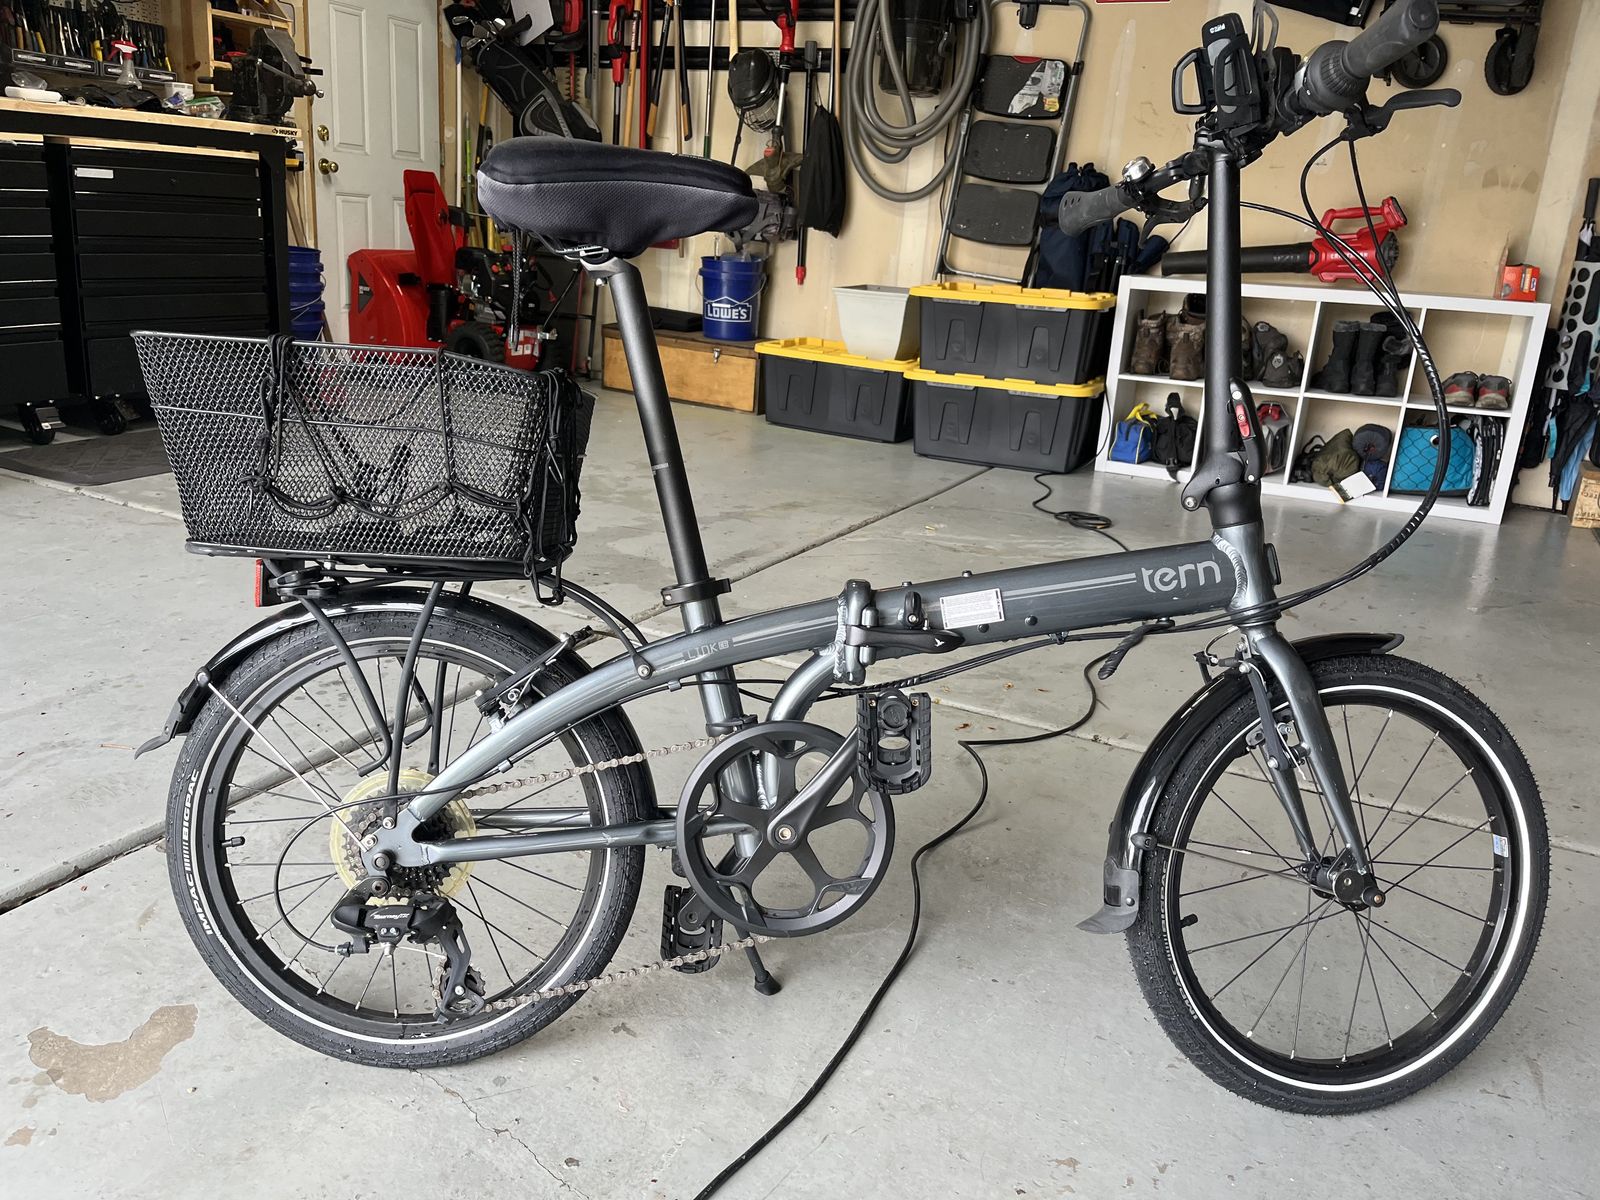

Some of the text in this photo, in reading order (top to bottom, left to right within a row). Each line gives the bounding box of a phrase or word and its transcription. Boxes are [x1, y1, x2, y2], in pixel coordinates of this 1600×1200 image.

[707, 304, 747, 319] LOWE'S
[1141, 560, 1221, 593] tern
[182, 768, 213, 936] IMPAC BIGPAC
